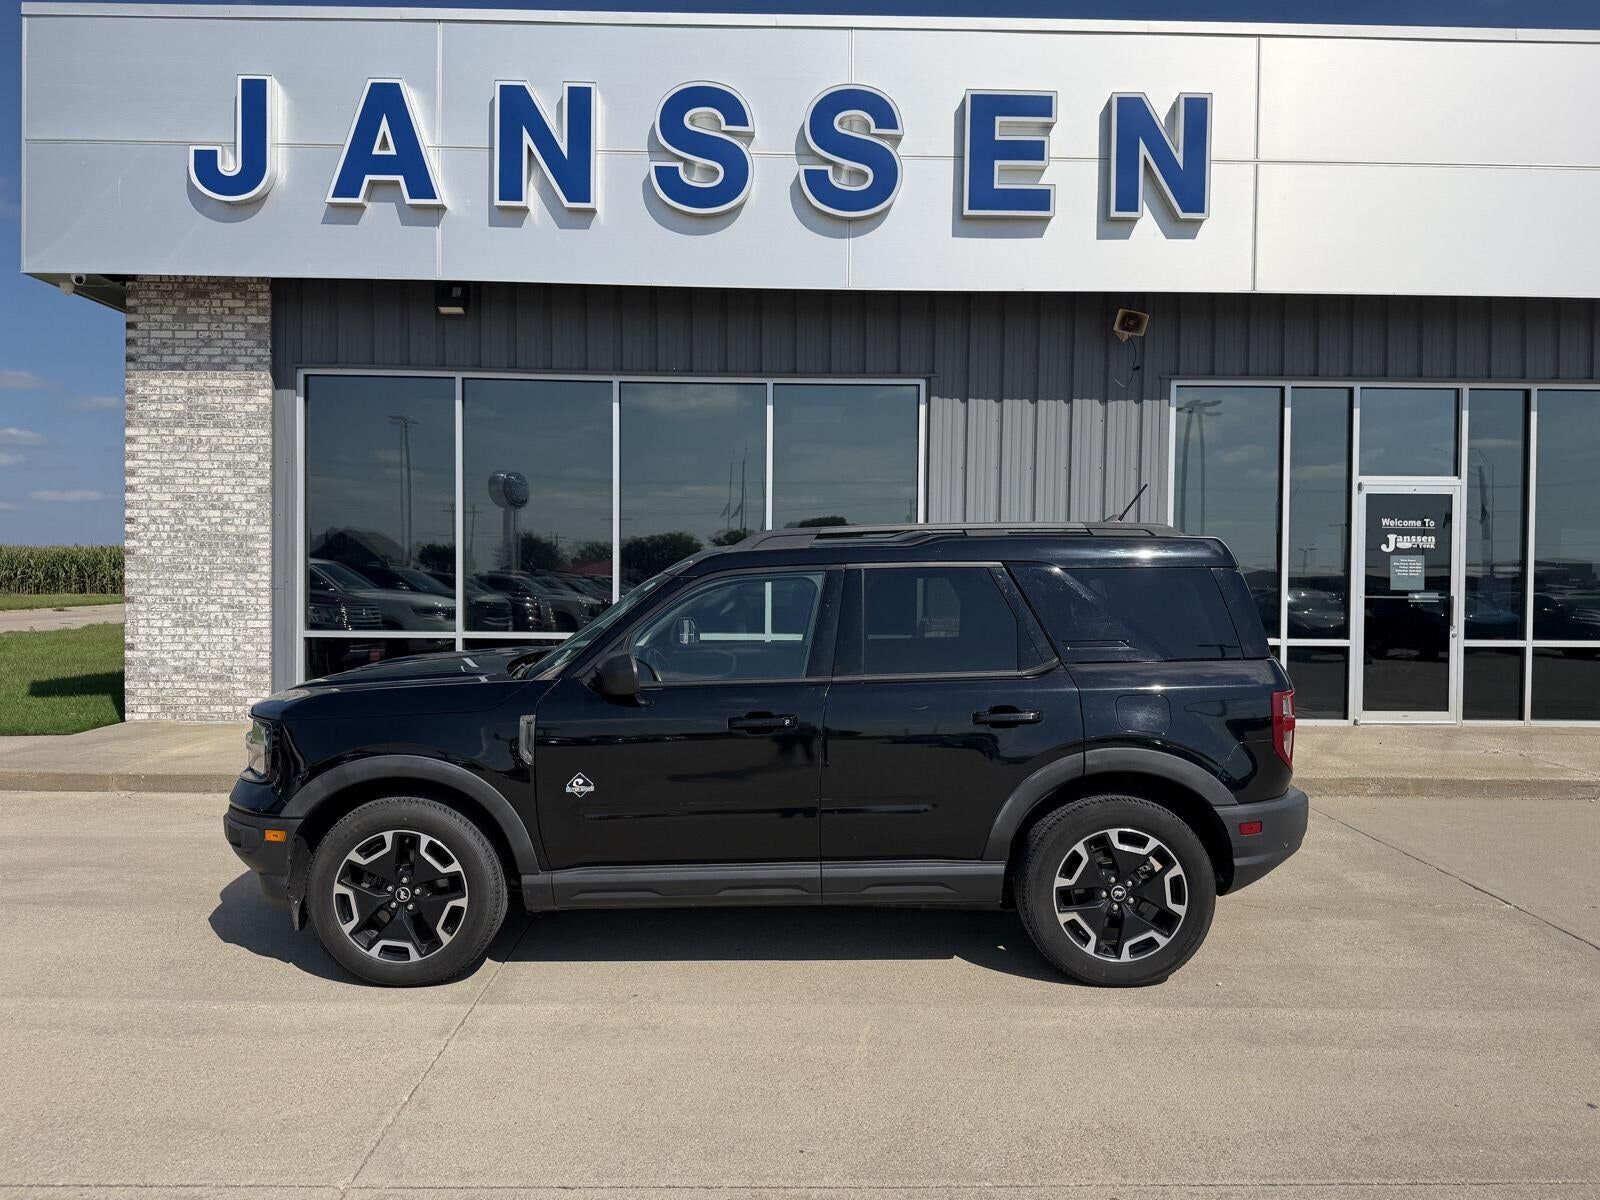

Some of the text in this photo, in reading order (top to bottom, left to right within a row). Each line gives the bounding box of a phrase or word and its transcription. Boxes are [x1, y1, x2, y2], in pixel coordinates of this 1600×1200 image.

[188, 74, 1214, 219] JANSSEN
[1382, 518, 1434, 526] Welcome To
[1380, 534, 1436, 552] Janssen
